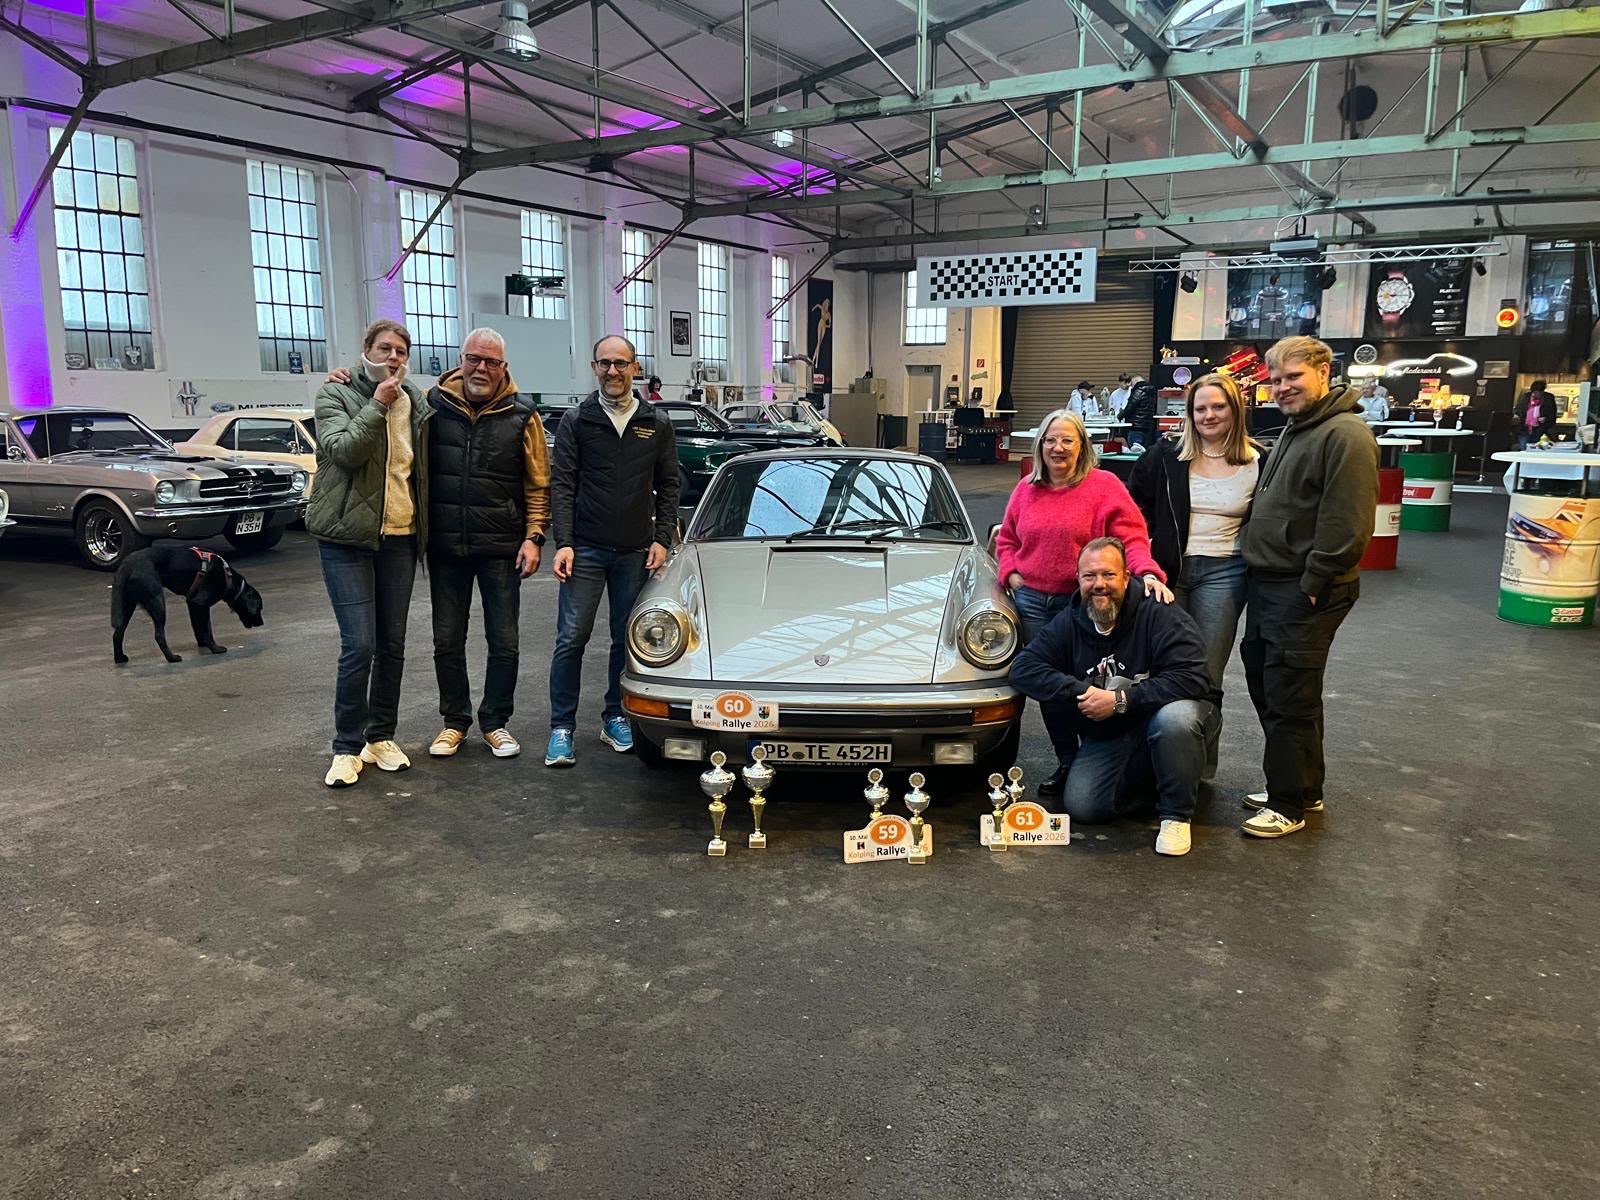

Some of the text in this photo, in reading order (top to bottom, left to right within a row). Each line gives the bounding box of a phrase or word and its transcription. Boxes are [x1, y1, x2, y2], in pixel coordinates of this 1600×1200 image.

[987, 274, 1020, 287] START
[723, 699, 745, 713] 60
[722, 719, 752, 729] Rallye
[753, 720, 775, 728] 2026
[763, 743, 889, 760] PB TE 452H
[1015, 811, 1035, 826] 61
[878, 824, 898, 840] 59
[1012, 832, 1043, 843] Rallye
[1044, 833, 1066, 841] 2026
[848, 850, 875, 859] Kolping
[876, 846, 906, 856] Rallye
